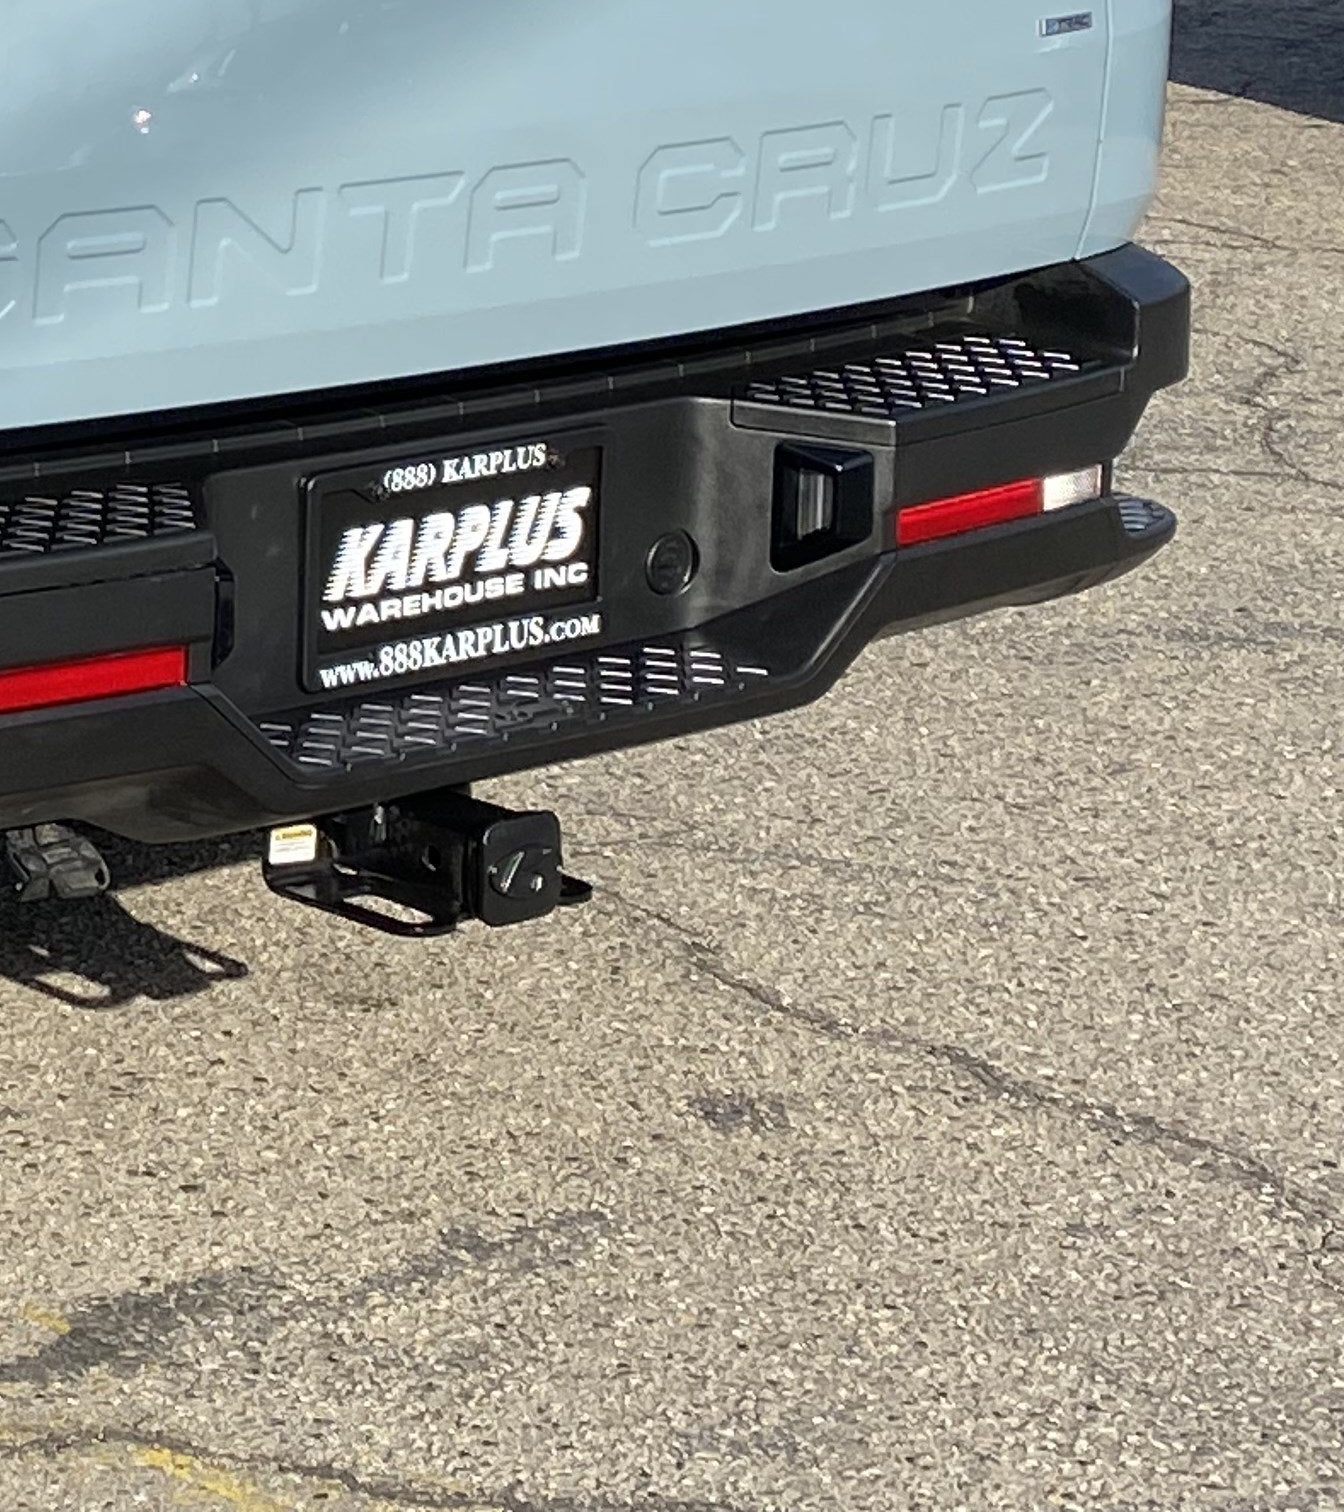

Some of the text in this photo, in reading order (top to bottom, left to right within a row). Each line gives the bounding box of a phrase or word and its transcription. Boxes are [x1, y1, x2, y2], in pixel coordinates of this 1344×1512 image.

[632, 88, 1055, 248] CRUZ
[382, 442, 548, 492] (888) KARPLUS
[321, 486, 592, 602] KARPLUS
[320, 561, 589, 632] WAREHOUSE INC
